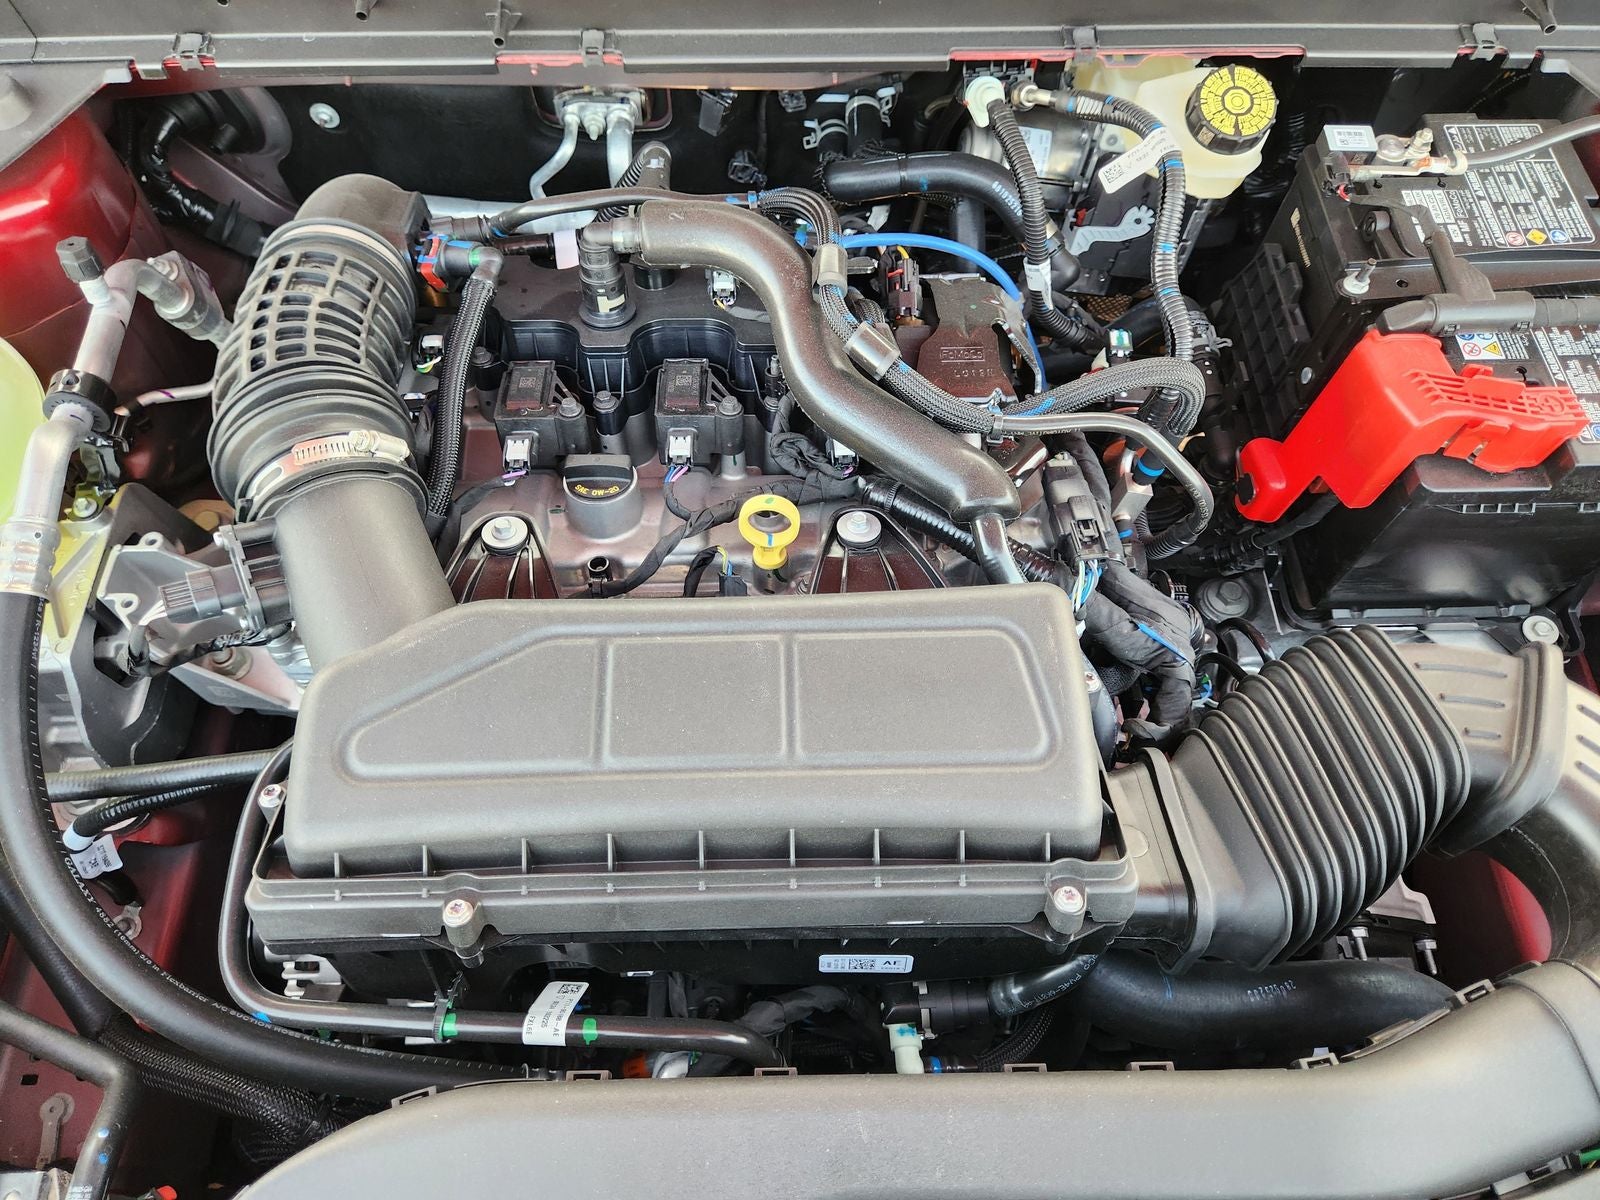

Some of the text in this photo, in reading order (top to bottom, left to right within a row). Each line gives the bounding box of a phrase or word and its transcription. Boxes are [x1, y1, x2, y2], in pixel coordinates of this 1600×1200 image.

[942, 349, 984, 360] FoMoCo
[575, 484, 590, 495] SAE
[64, 857, 96, 904] GALAXY
[229, 1009, 272, 1029] SUCTION
[274, 1026, 301, 1039] HOSE
